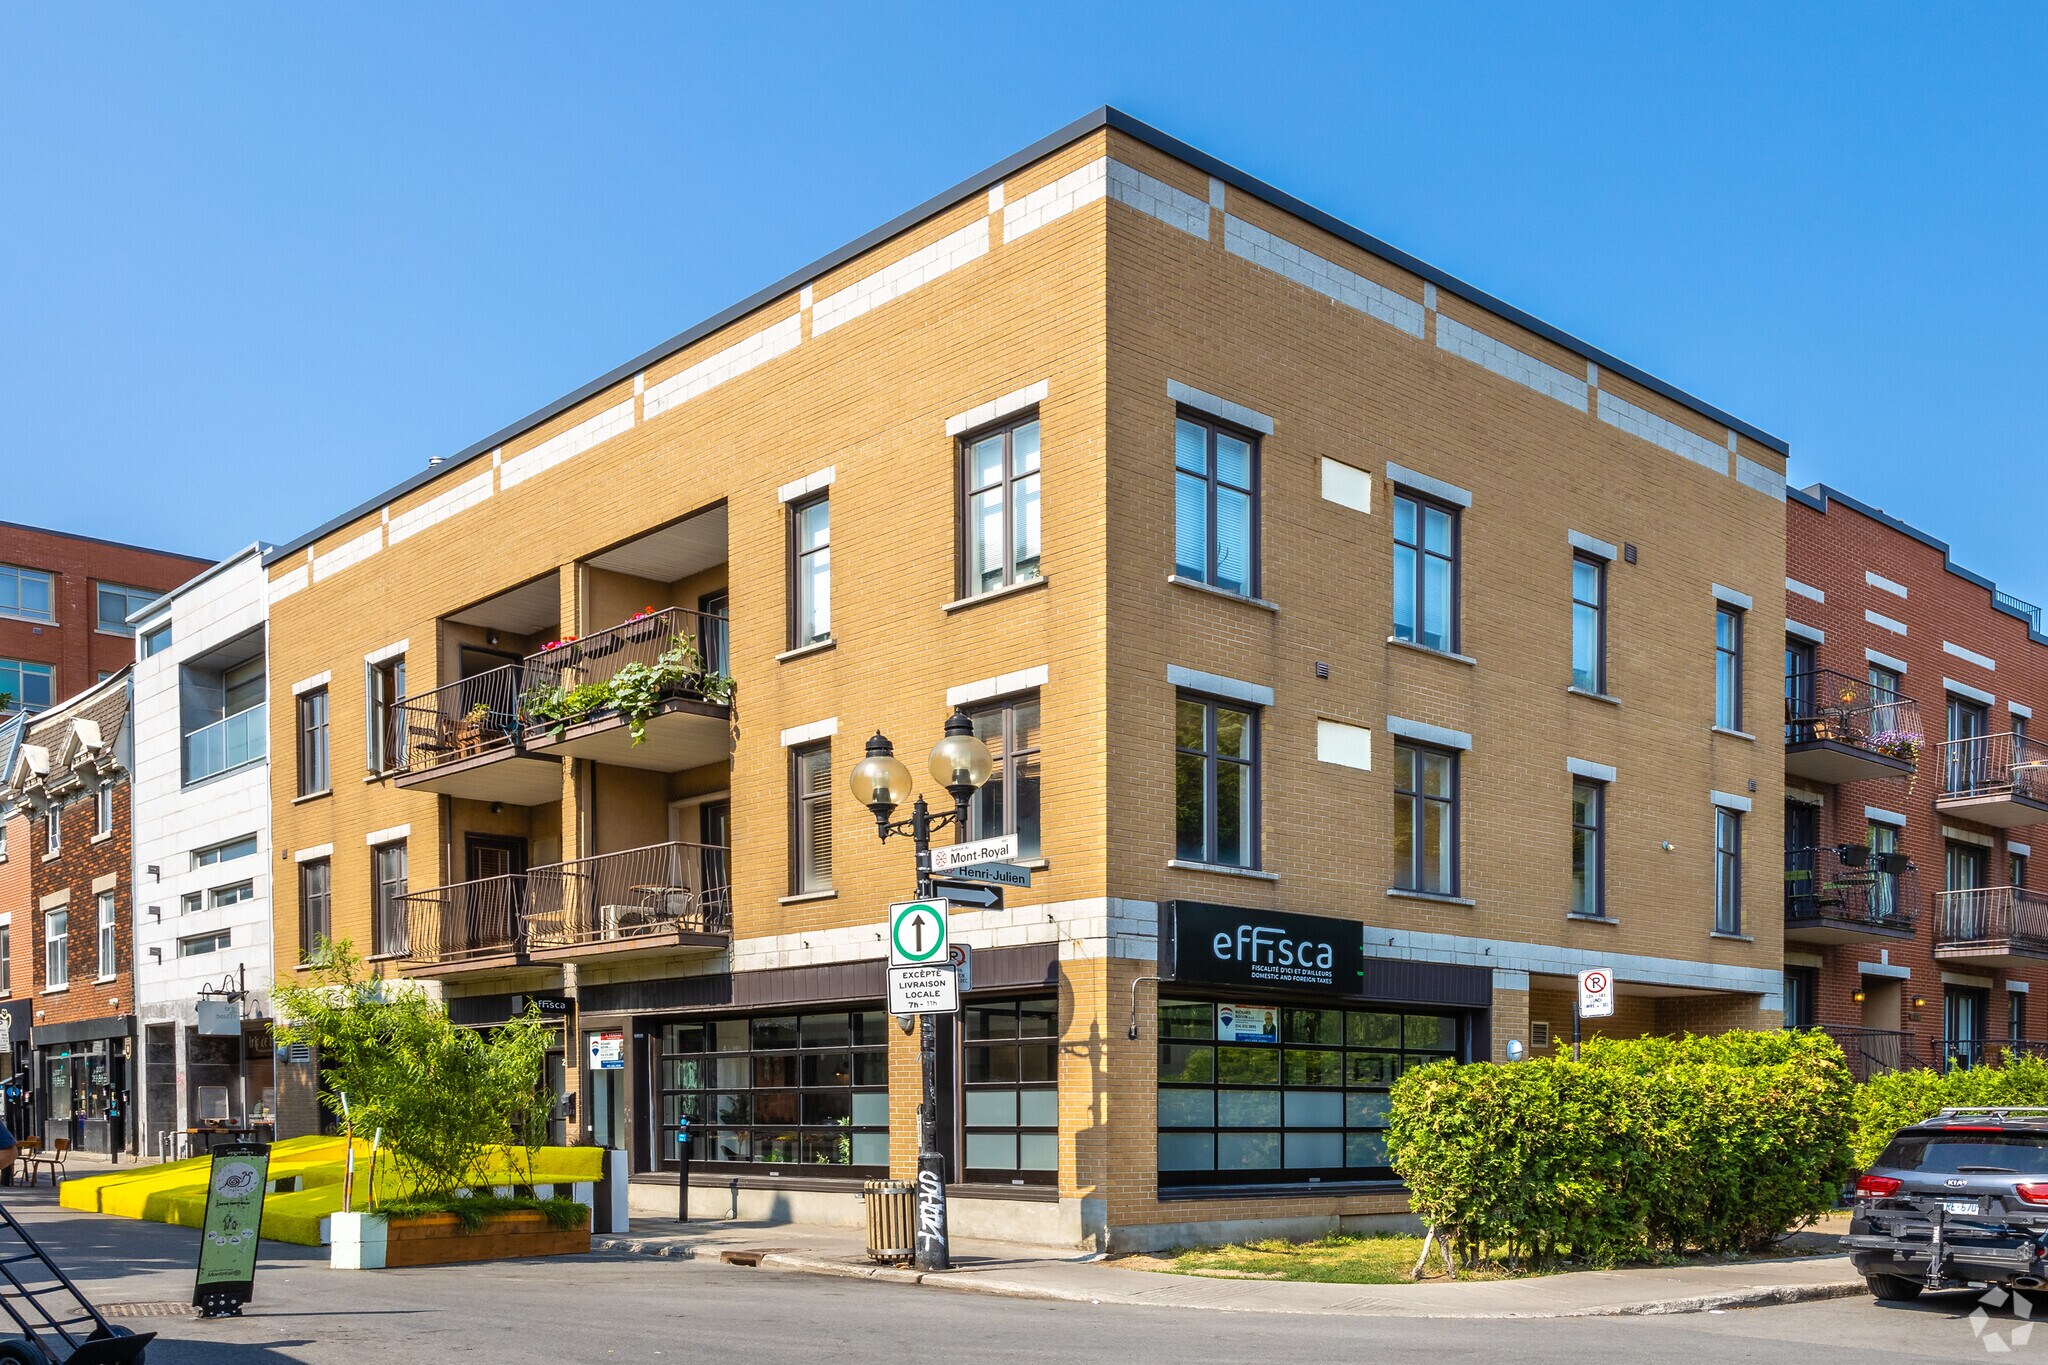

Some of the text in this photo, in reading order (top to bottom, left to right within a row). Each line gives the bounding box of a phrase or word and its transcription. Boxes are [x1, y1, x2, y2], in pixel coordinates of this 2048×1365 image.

[950, 844, 1009, 864] Mont-Royal
[959, 866, 1025, 884] Henri-Julien
[1213, 925, 1333, 969] effisca
[1251, 964, 1279, 973] FISCALITÉ
[1302, 968, 1332, 977] D'AILLEURS
[1251, 972, 1279, 980] DOMESTIC
[1293, 975, 1316, 983] FOREIGN
[899, 980, 946, 989] LIVRAISON
[905, 990, 941, 999] LOCALE
